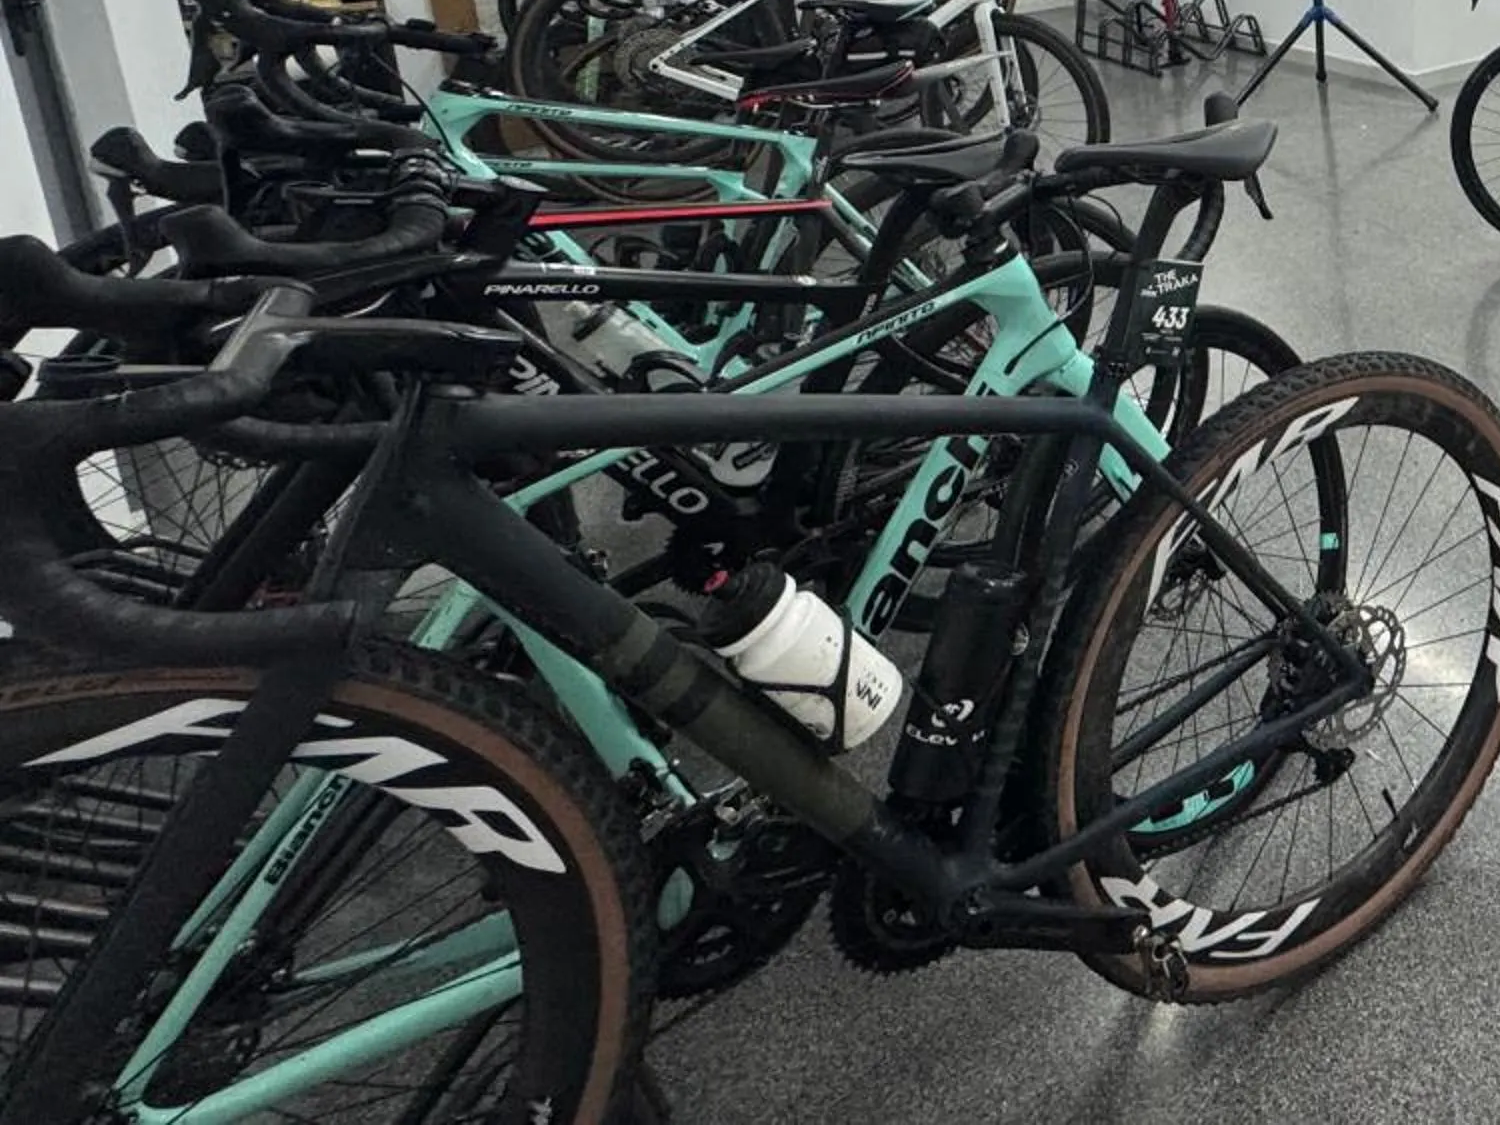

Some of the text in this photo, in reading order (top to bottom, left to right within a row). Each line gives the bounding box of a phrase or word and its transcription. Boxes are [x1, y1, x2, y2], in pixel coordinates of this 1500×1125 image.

[484, 283, 601, 296] PINARELLO
[1151, 305, 1190, 330] 433
[264, 773, 350, 885] Bianch
